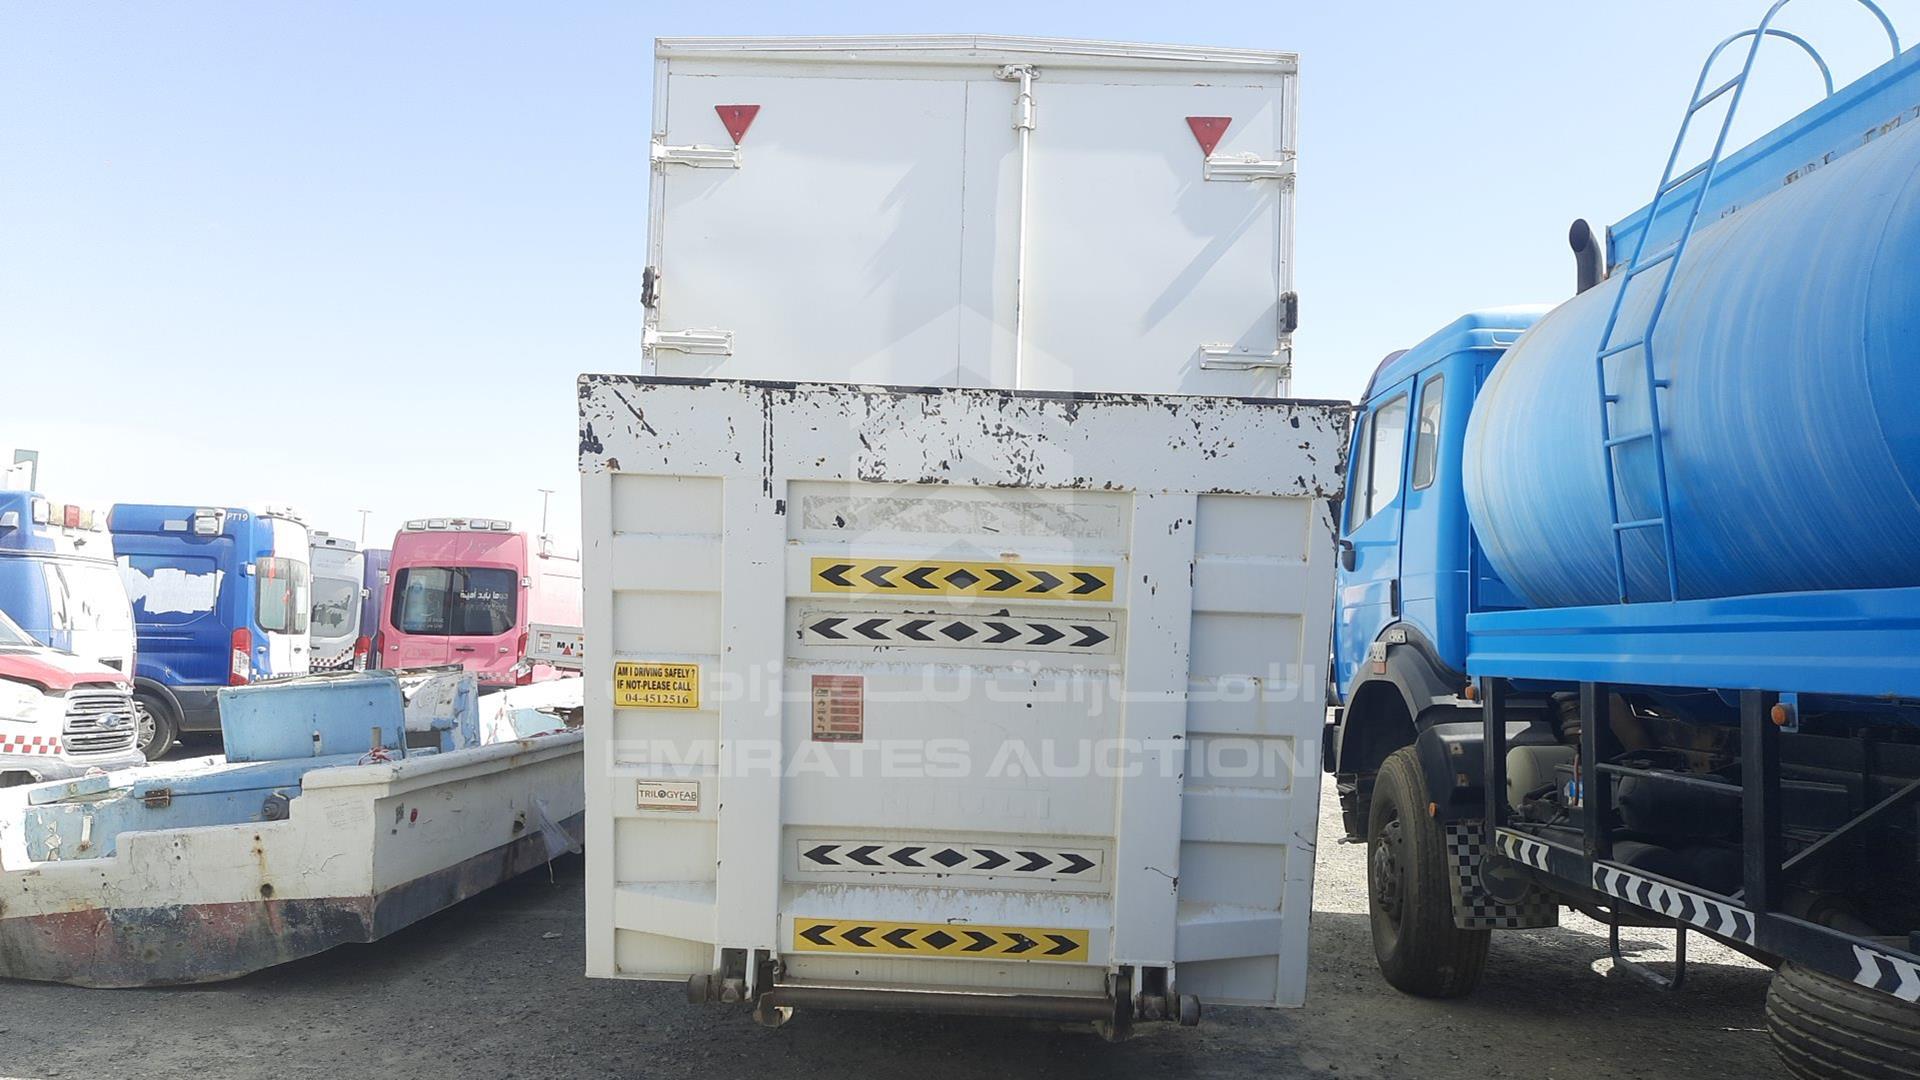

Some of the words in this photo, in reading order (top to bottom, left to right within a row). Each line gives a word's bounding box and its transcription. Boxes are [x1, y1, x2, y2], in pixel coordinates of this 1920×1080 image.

[226, 512, 249, 522] PT19
[617, 666, 628, 677] AM
[634, 667, 663, 678] DRIVING
[664, 668, 690, 679] SAFELY
[616, 680, 624, 689] IF
[625, 680, 671, 691] NOT-PLEASE
[673, 681, 692, 692] CALL
[625, 693, 689, 705] 04-4512516
